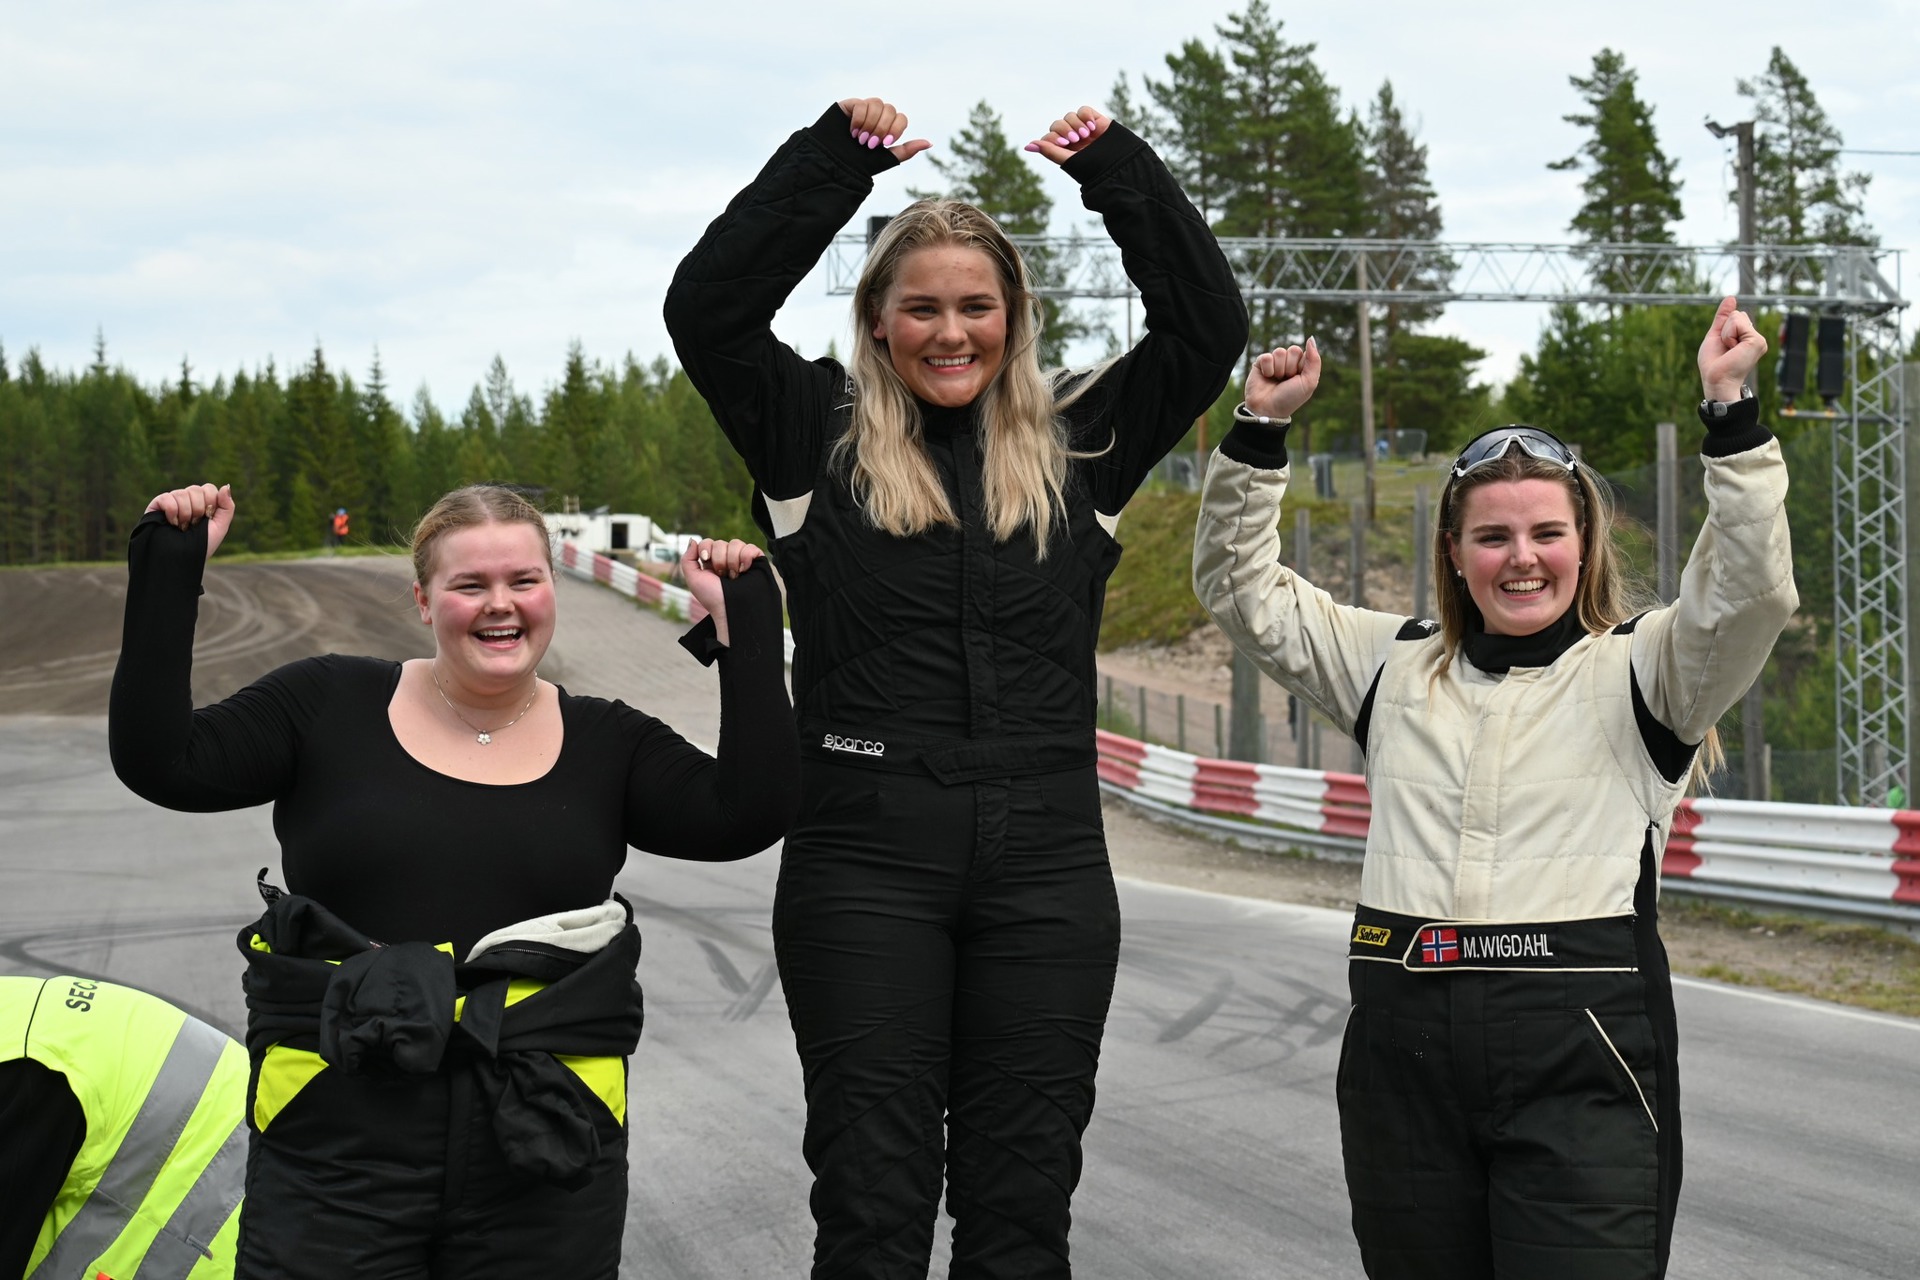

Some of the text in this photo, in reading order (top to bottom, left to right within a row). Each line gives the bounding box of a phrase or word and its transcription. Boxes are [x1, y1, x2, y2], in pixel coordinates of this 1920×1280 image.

[1358, 927, 1388, 943] Sabelt
[1463, 933, 1554, 959] M.WIGDAHL
[65, 980, 99, 1012] SEC
